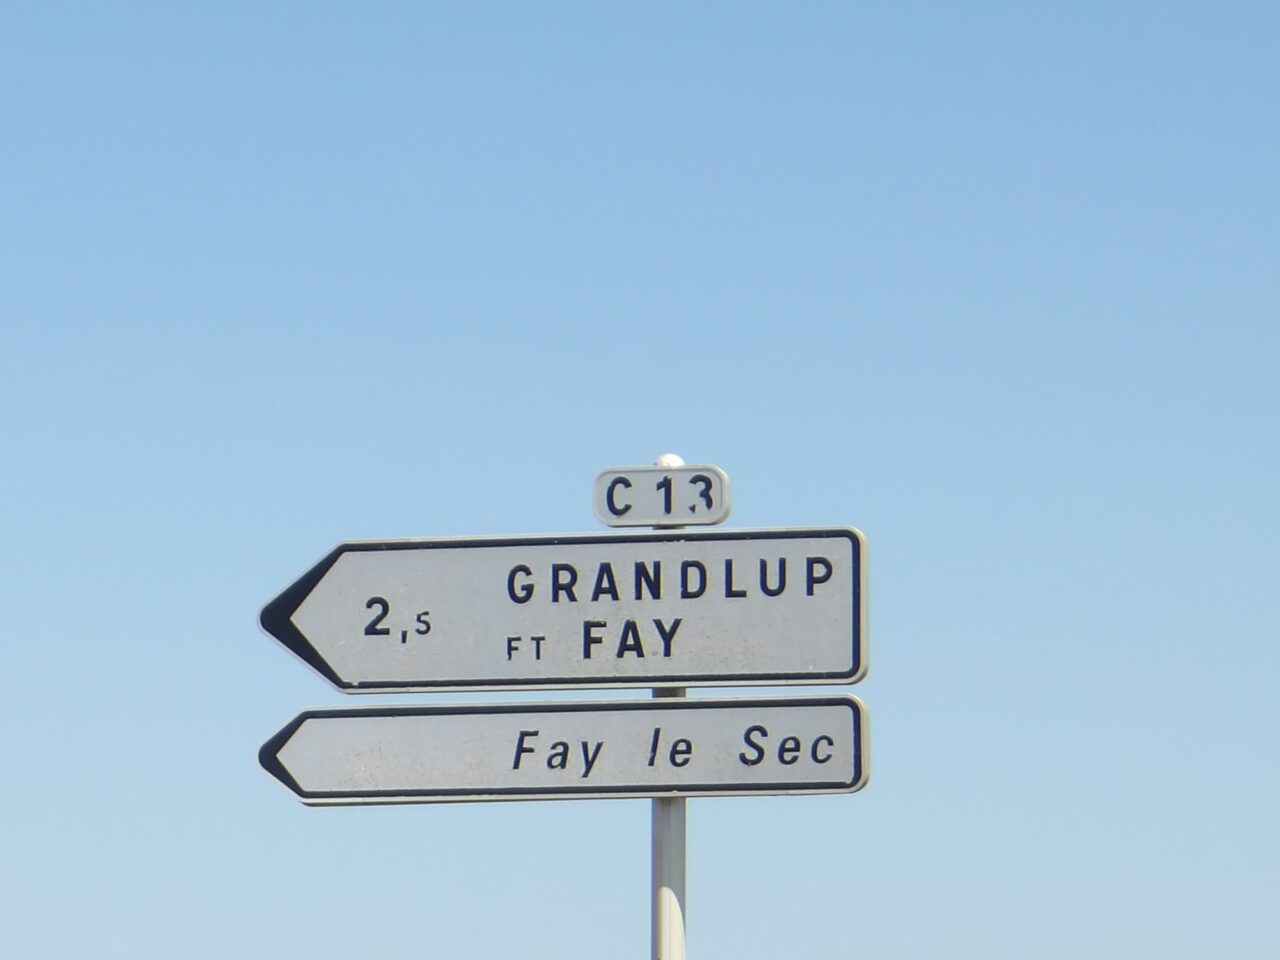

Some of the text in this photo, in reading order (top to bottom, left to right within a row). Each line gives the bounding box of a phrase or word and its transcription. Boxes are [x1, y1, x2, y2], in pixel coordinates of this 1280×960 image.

[606, 474, 713, 516] C 13
[507, 556, 832, 604] GRANDLUP
[363, 596, 431, 643] 2,5
[583, 618, 682, 660] FAY
[512, 725, 835, 779] Fay le Sec
